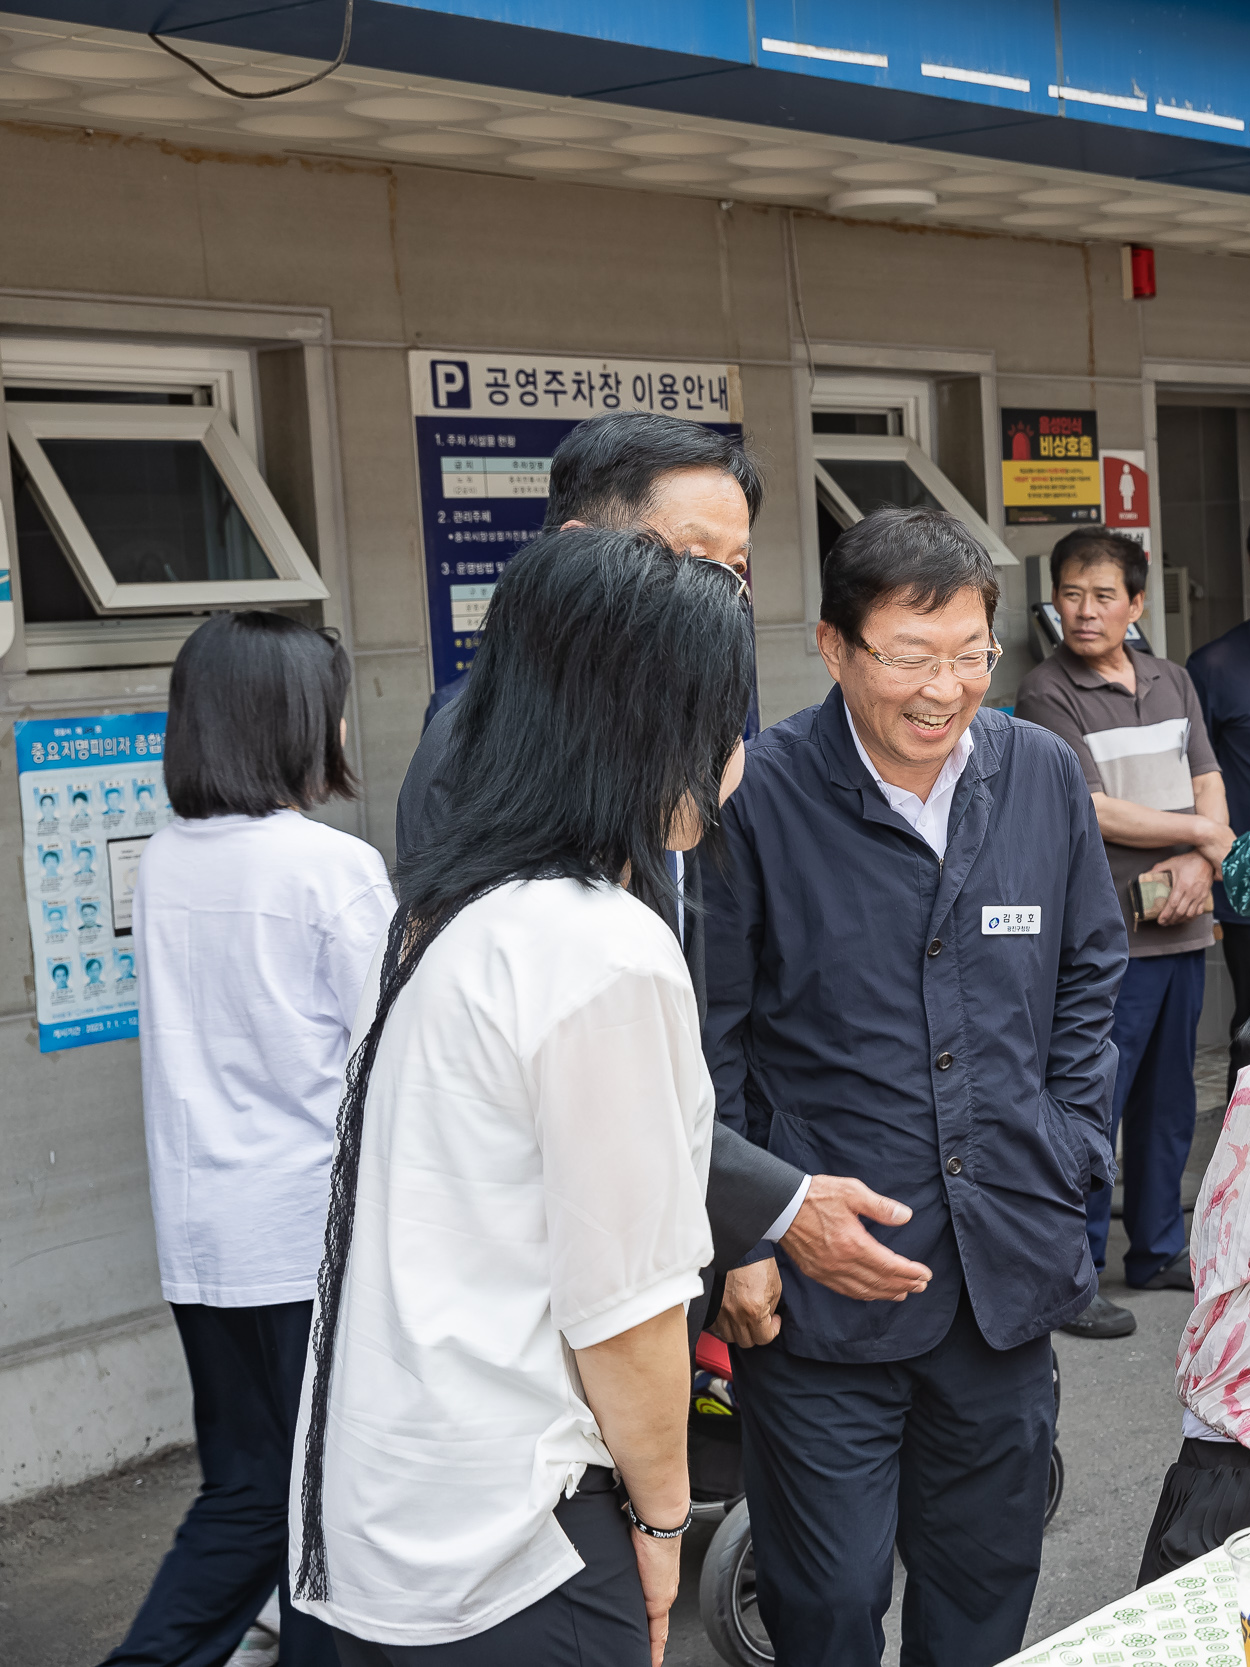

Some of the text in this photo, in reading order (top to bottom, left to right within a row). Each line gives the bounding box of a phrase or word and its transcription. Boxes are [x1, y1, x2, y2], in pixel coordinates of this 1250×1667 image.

[485, 366, 730, 411] 공영주차장 이용안내
[1039, 435, 1093, 458] 비상호출
[31, 733, 167, 763] 중요지명피의자 종합
